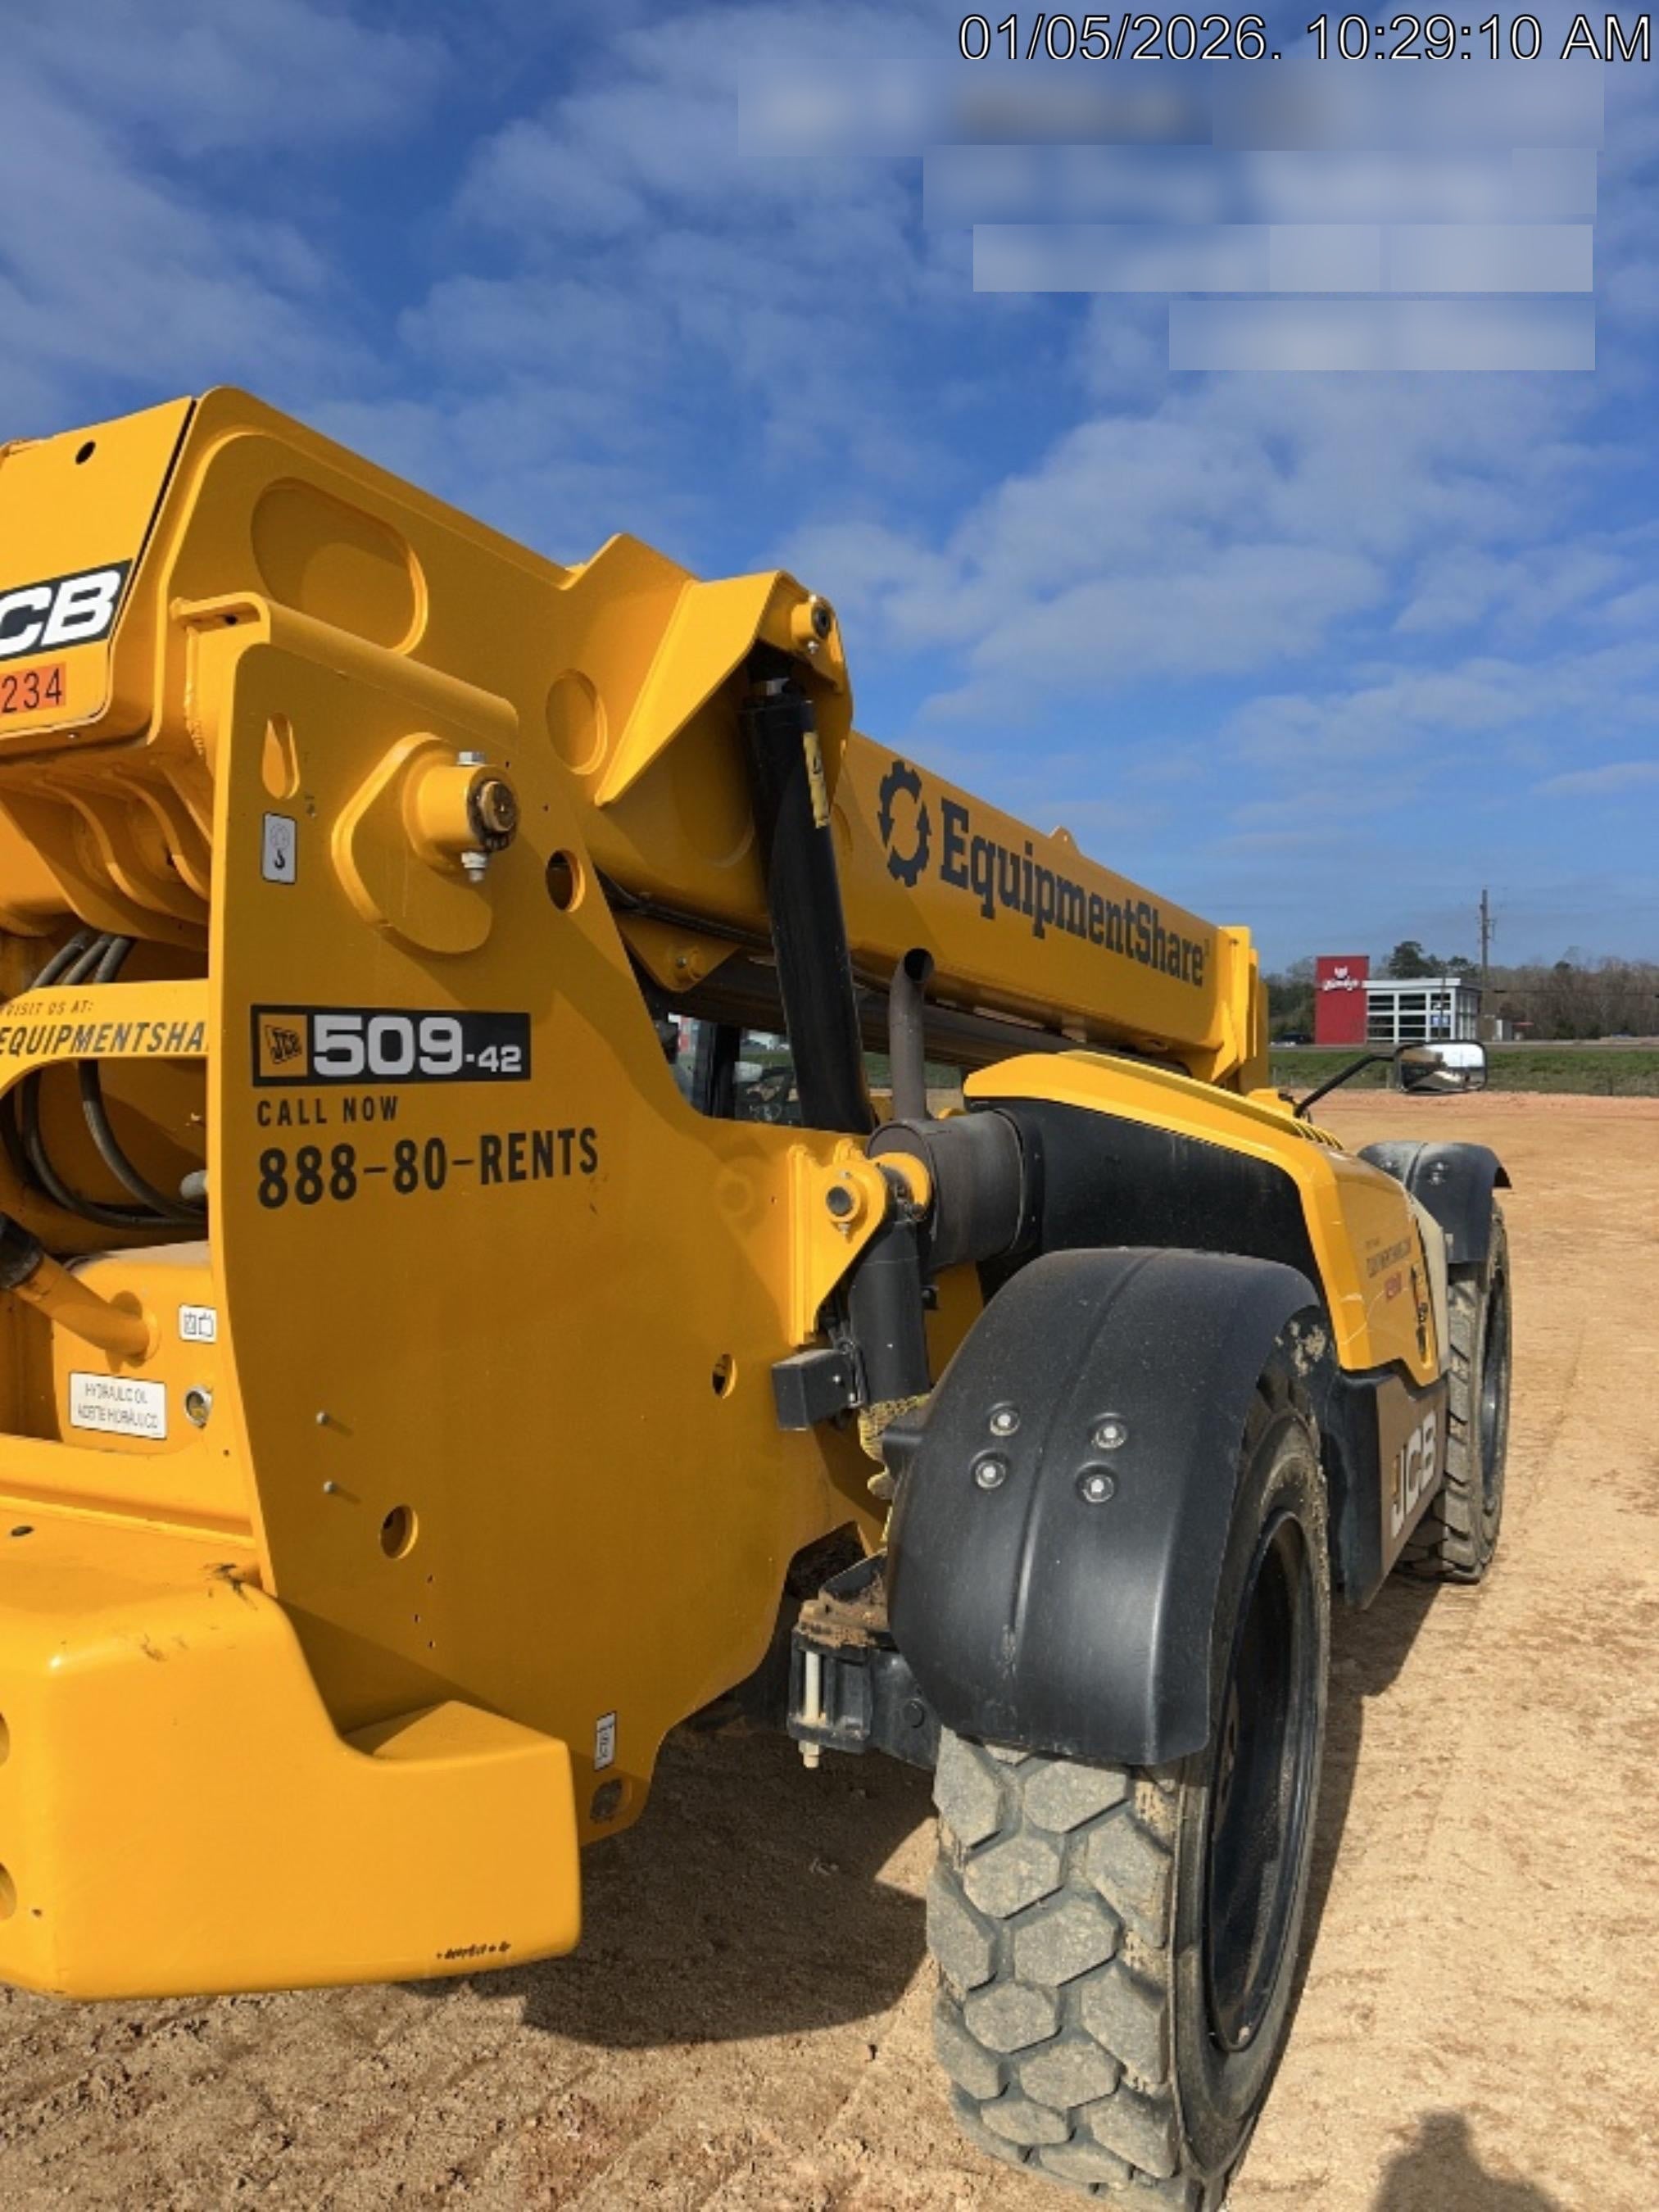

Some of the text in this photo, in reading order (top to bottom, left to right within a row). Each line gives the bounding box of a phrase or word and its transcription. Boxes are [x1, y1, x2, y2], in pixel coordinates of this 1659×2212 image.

[940, 796, 1203, 987] EquipmentShare
[7, 1002, 43, 1016] VISIT
[0, 1022, 208, 1057] EQUIPMENTSHA
[256, 1095, 399, 1126] CALL NOW
[258, 1126, 599, 1209] 888-80-RENTS
[1390, 1408, 1437, 1539] JCB
